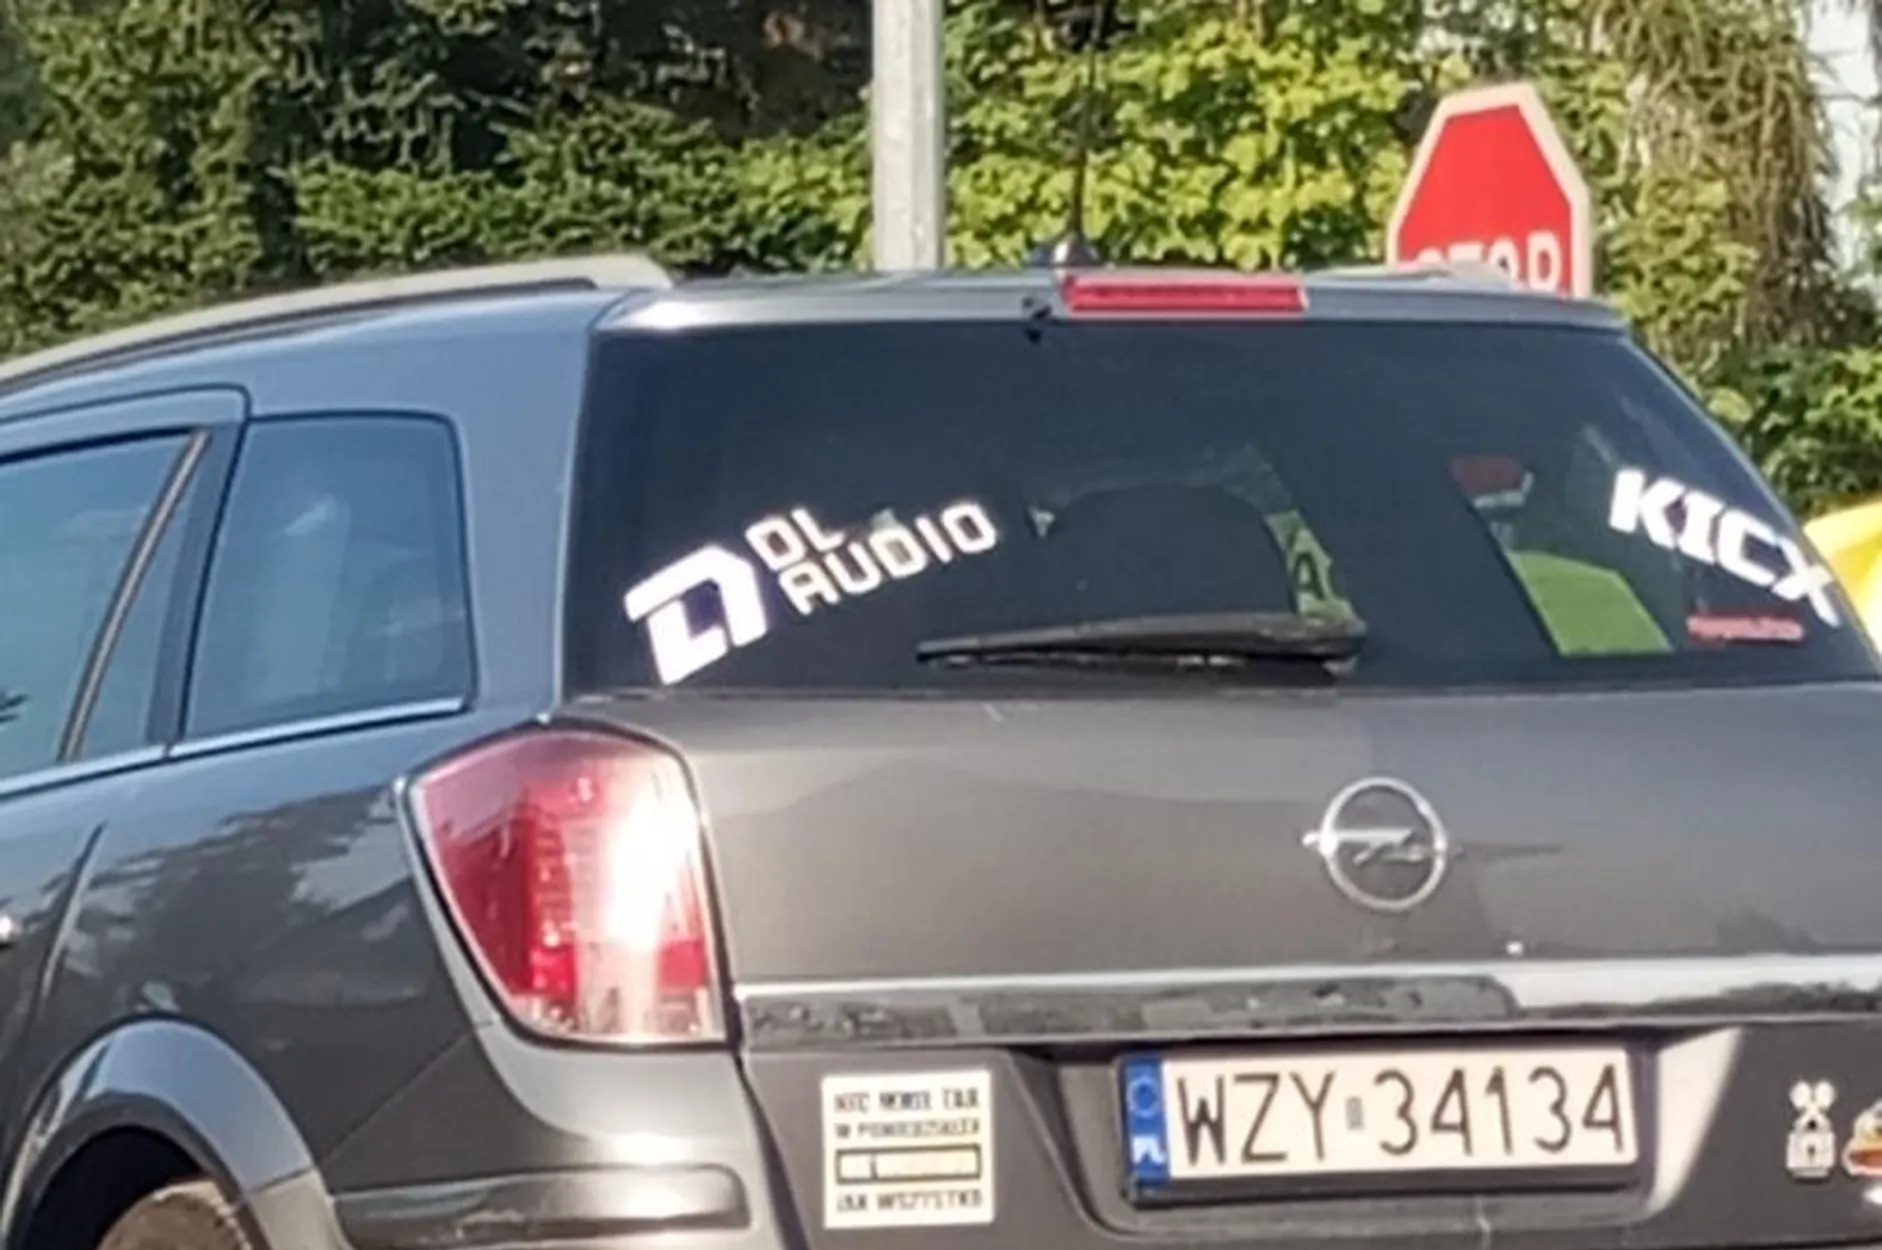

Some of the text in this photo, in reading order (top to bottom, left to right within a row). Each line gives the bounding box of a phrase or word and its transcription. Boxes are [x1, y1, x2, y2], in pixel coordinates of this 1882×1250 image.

[745, 507, 845, 571] DL
[779, 502, 998, 615] AUDIO
[1608, 470, 1841, 629] KICX
[1177, 1063, 1625, 1166] WZY 34134
